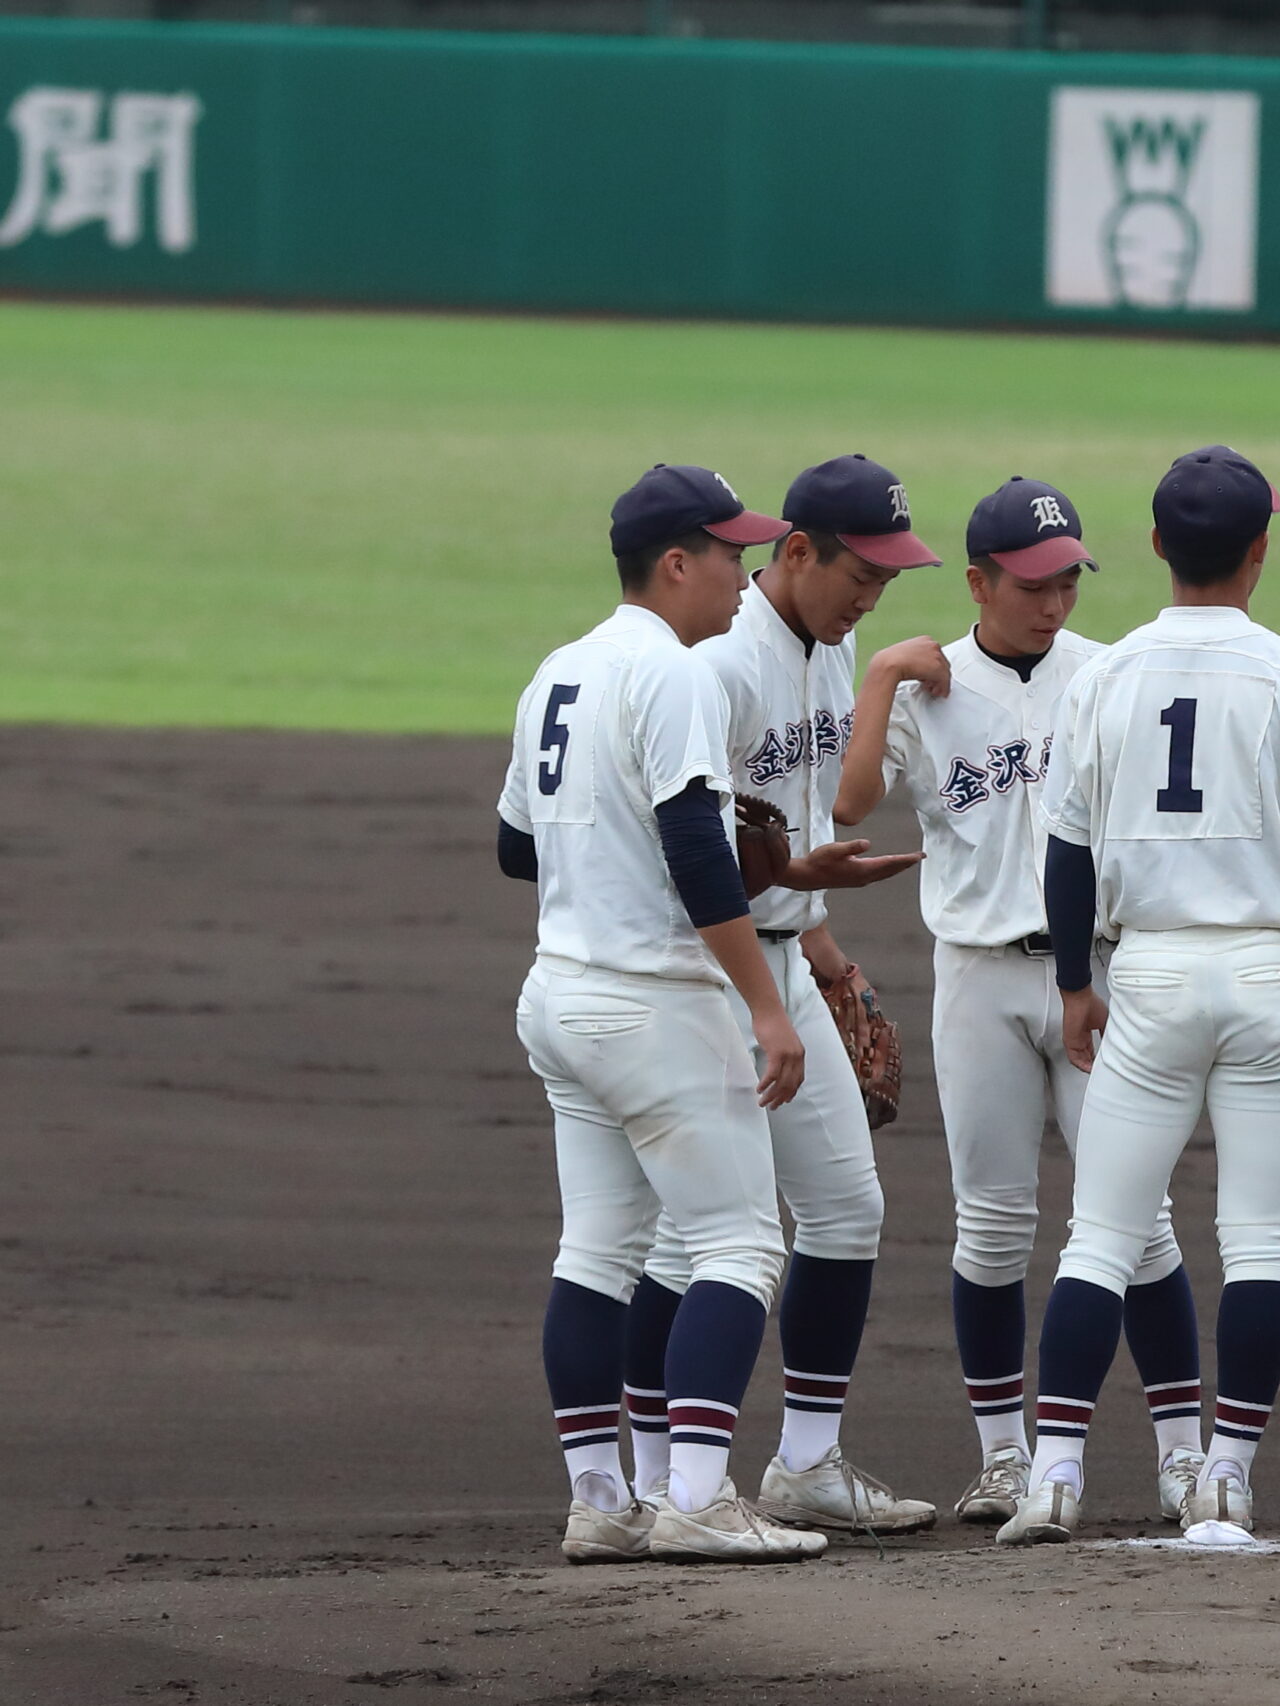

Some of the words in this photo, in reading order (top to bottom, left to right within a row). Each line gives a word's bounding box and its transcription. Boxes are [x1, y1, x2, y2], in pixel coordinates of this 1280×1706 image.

[1029, 496, 1069, 533] K
[538, 684, 581, 796] 5
[940, 731, 1054, 813] 金沢
[1157, 697, 1203, 813] 1
